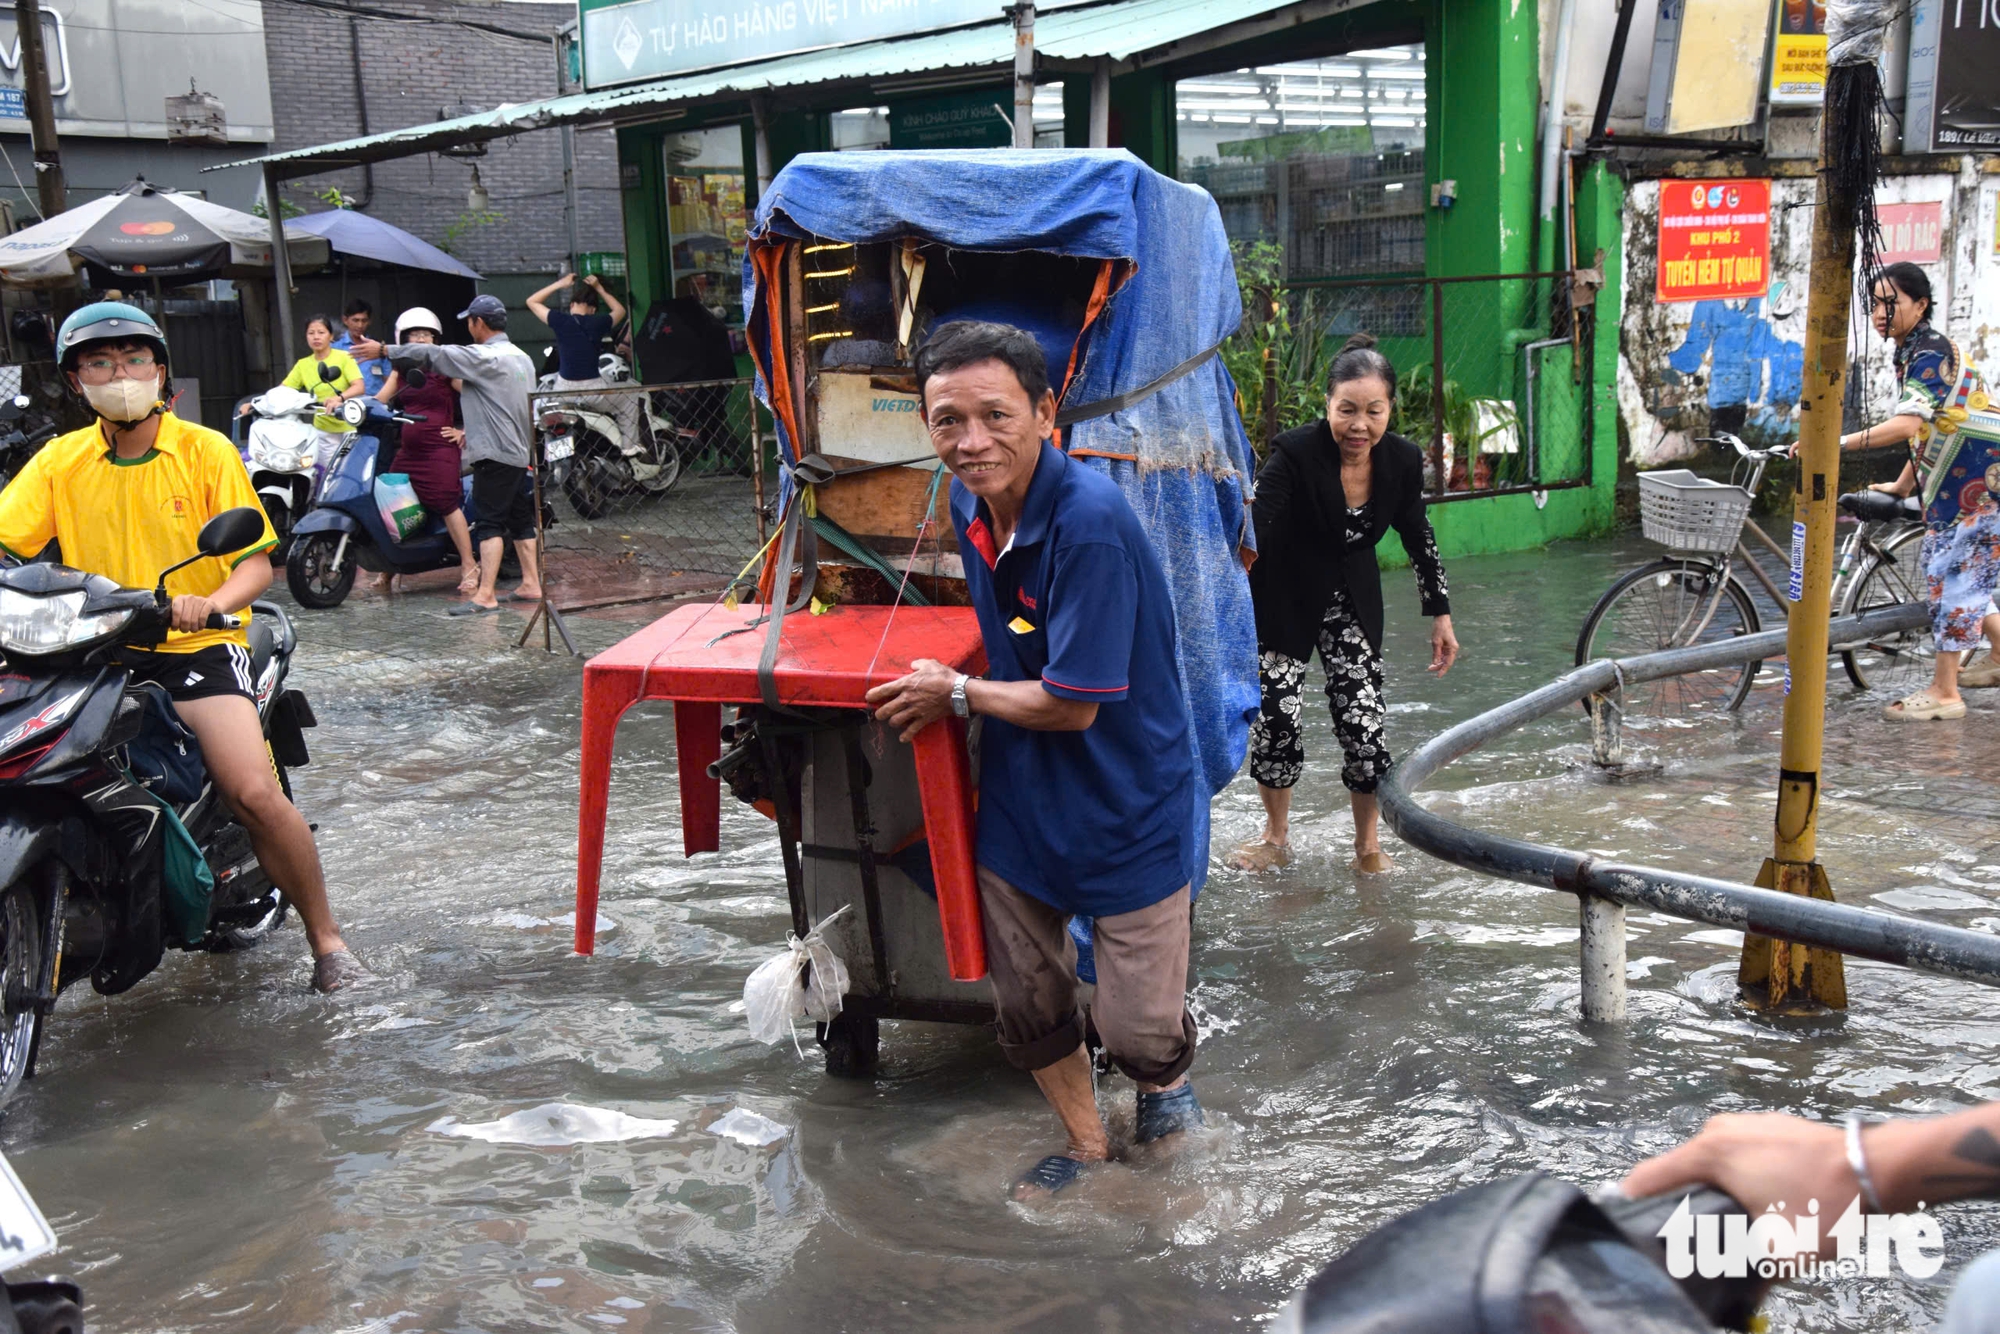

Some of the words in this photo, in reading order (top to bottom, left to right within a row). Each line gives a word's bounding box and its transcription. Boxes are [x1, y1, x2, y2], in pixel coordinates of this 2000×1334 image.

[650, 22, 677, 57] TỰ
[684, 12, 726, 48] HÀO
[734, 1, 797, 39] HÀNG
[1690, 232, 1710, 245] KHU
[1733, 231, 1740, 244] 2
[1665, 251, 1697, 288] TUYẾN
